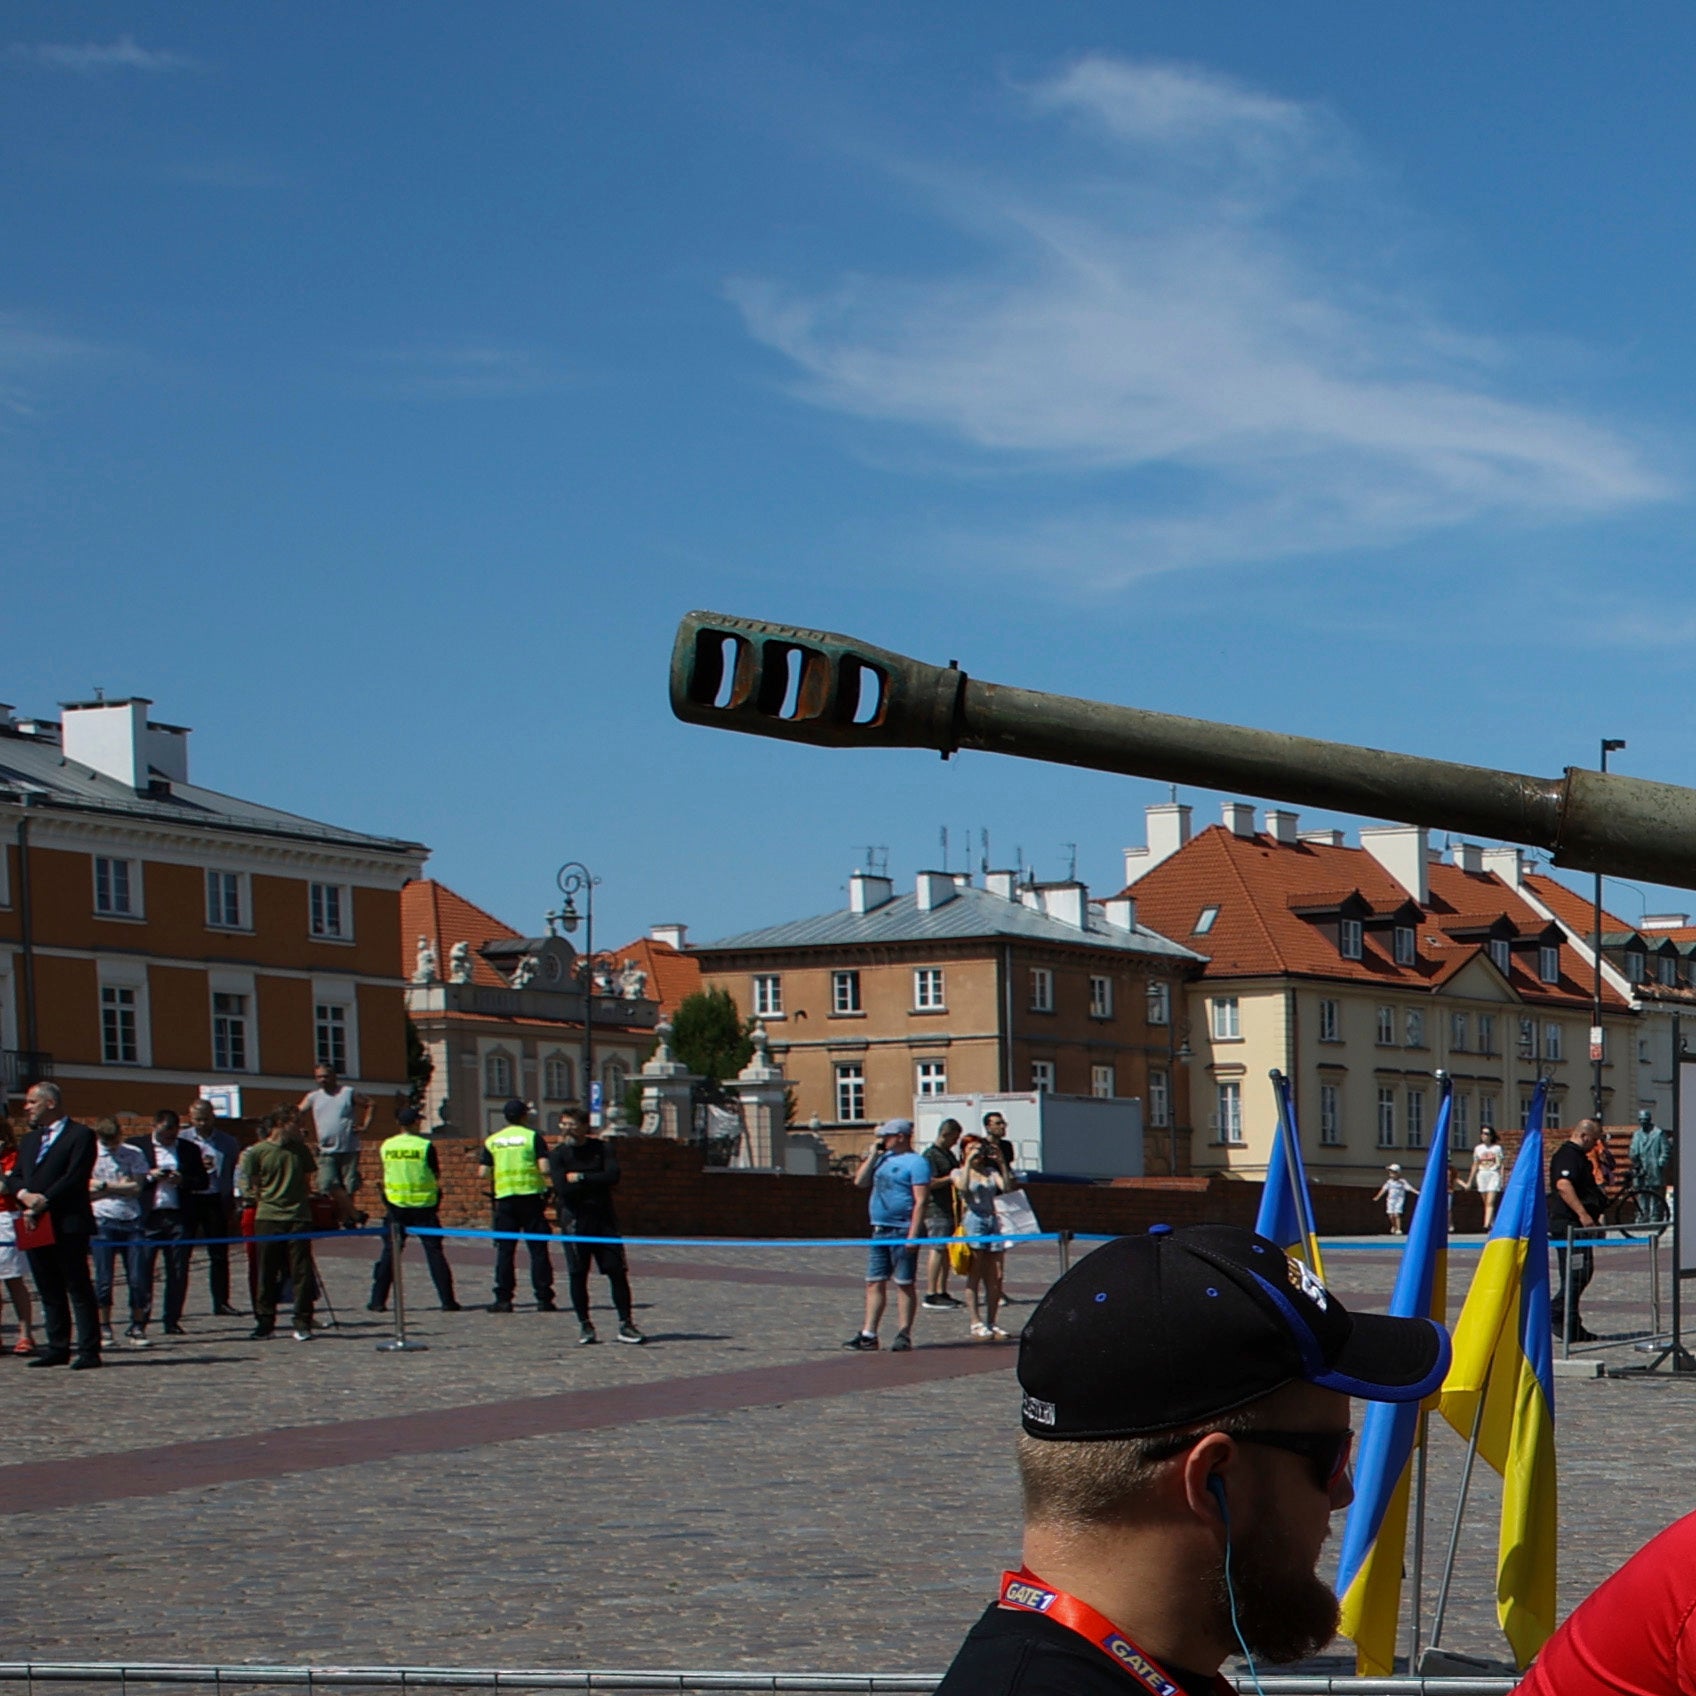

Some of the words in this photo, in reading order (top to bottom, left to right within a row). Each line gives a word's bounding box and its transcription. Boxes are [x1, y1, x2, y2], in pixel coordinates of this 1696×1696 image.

[385, 1149, 421, 1160] POLICJA
[1006, 1583, 1043, 1606] GATE
[1040, 1594, 1056, 1610] 1
[1111, 1640, 1162, 1687] GATE
[1161, 1684, 1176, 1696] 1
